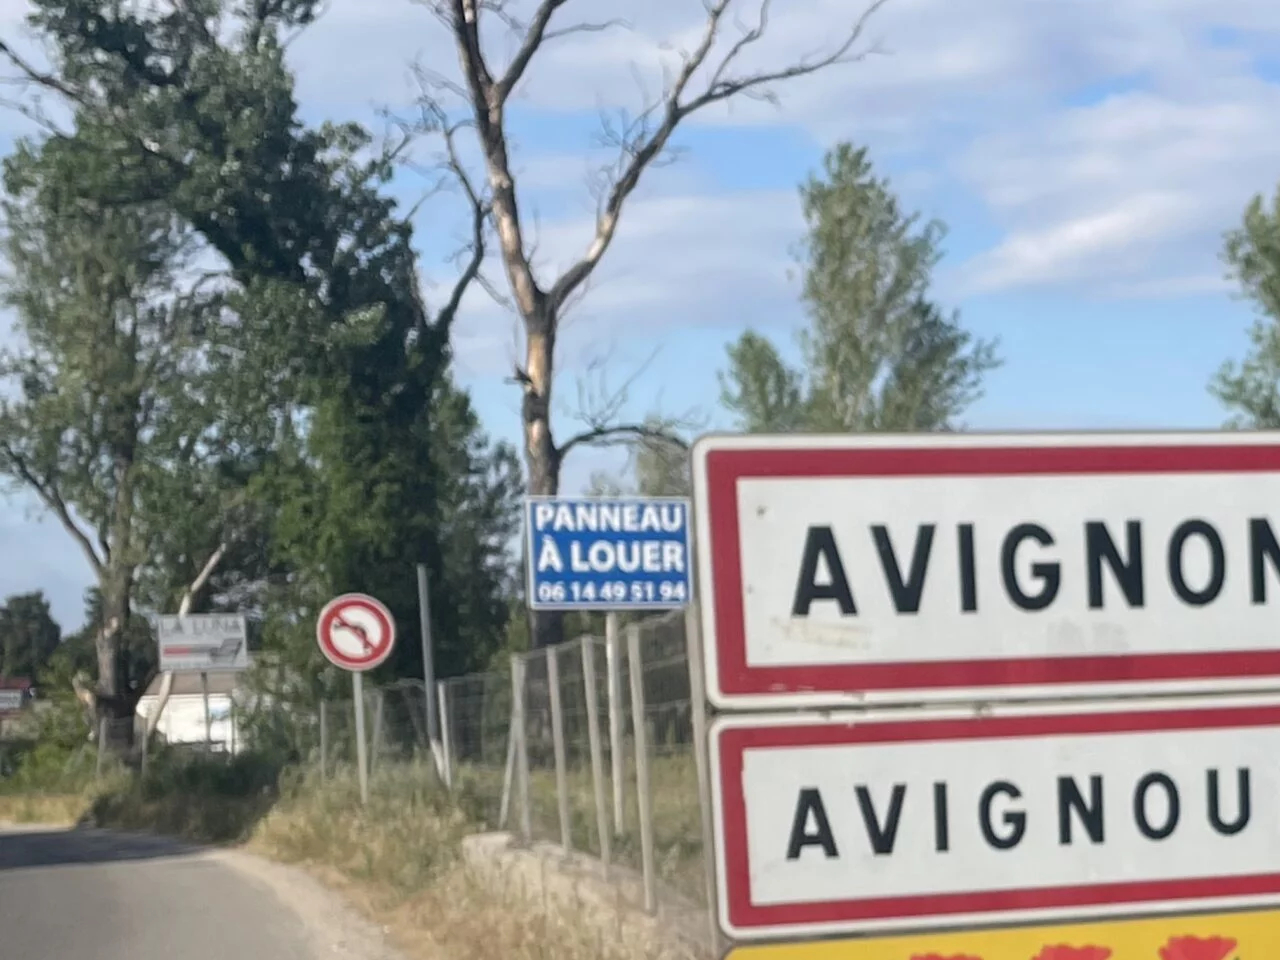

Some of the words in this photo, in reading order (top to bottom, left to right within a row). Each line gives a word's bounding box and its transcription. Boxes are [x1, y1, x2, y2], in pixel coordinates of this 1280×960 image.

[536, 504, 682, 532] PANNEAU
[538, 534, 564, 573] À
[571, 540, 685, 573] LOUER
[538, 581, 566, 601] 06
[571, 581, 596, 601] 14
